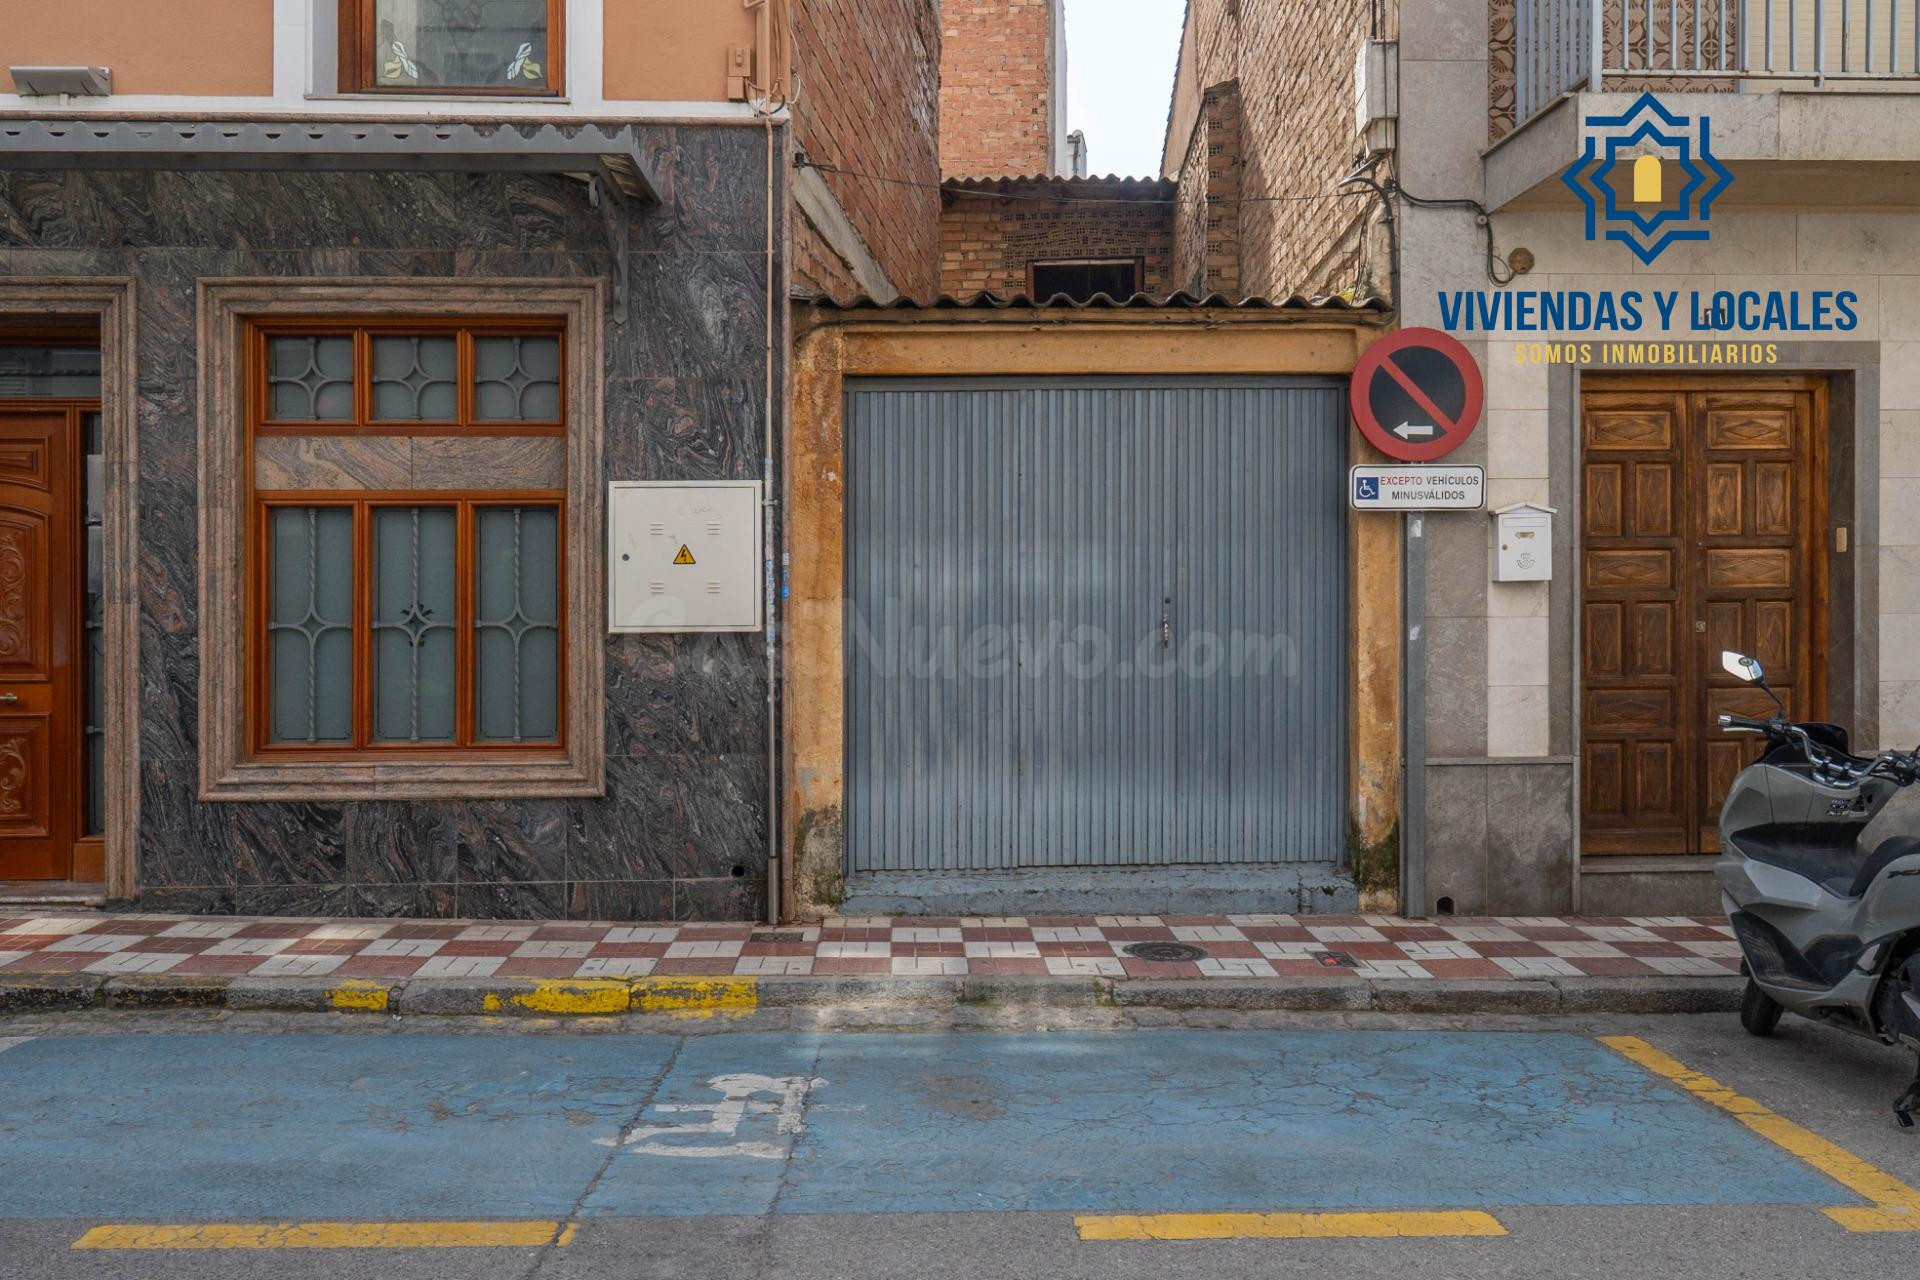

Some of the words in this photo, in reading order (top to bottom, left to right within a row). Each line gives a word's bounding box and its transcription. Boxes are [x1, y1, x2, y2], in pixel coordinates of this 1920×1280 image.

[1380, 476, 1423, 486] EXCEPTO
[1426, 474, 1479, 486] VEHÍCULOS
[1391, 489, 1466, 500] MINUSVÁLIDOS
